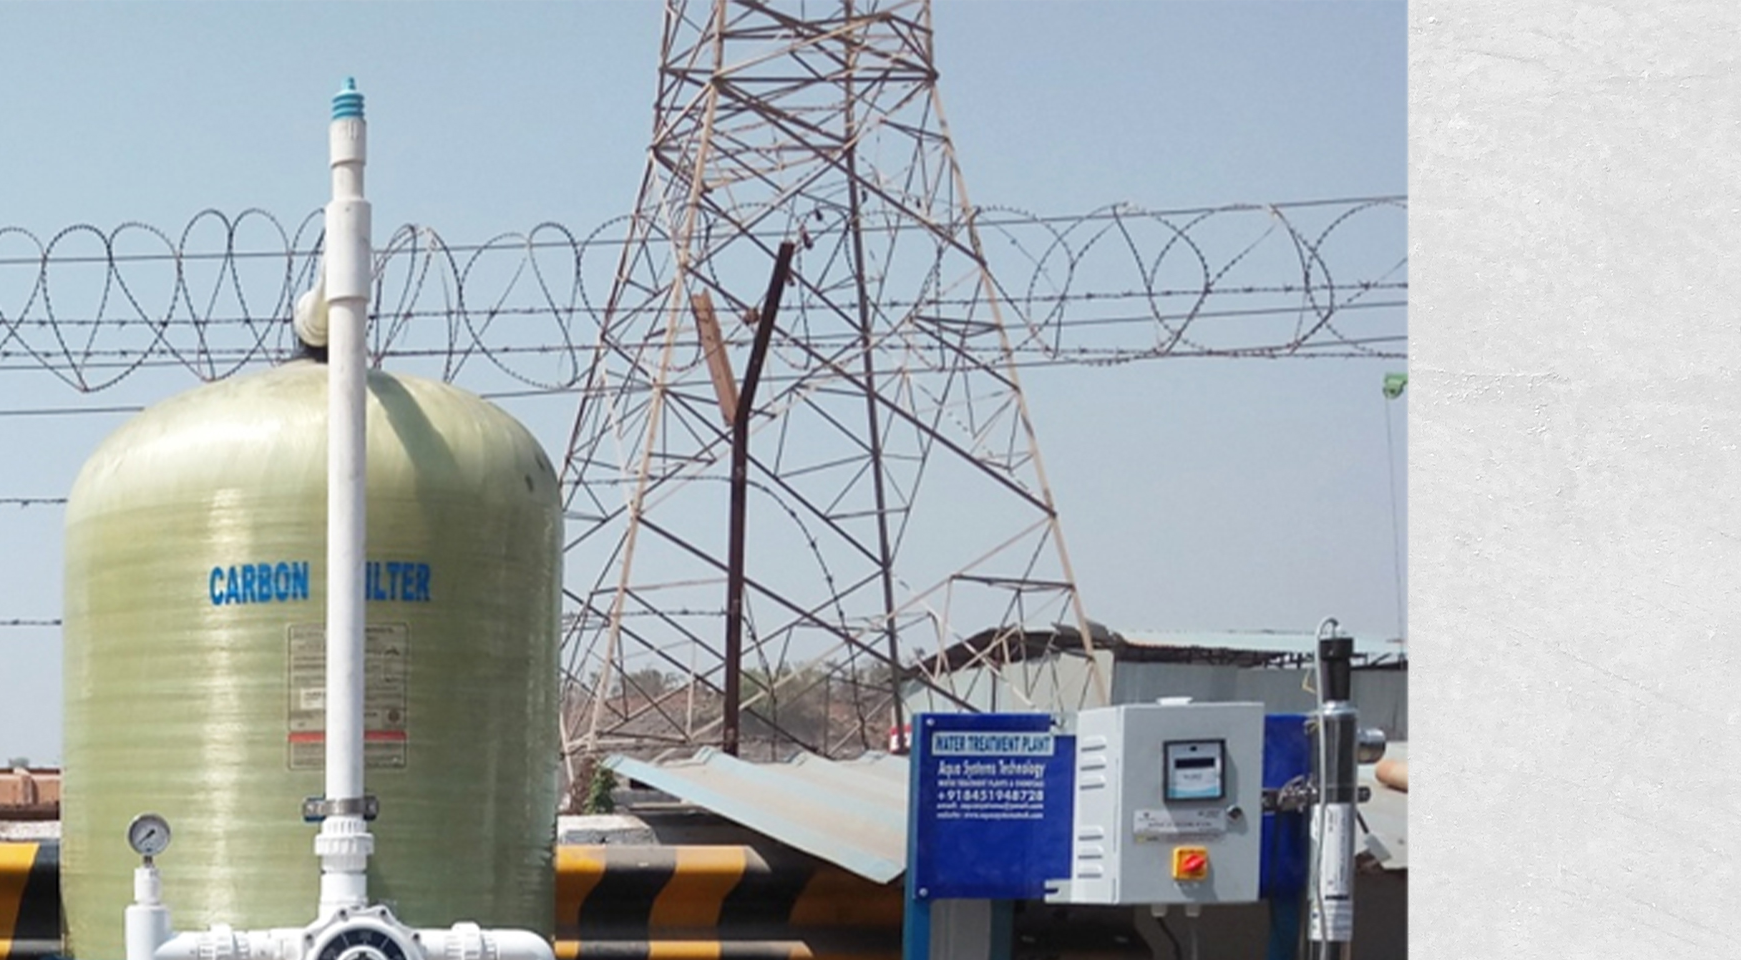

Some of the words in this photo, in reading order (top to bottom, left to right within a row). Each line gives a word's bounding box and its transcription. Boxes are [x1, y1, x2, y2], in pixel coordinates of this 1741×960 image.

[209, 561, 309, 606] CARBON
[365, 561, 432, 603] ILTER
[936, 735, 965, 752] WATER
[967, 735, 1019, 752] TREATMENT
[1022, 735, 1051, 752] PLANT
[938, 759, 961, 779] Aqua
[963, 759, 996, 779] Systems
[999, 759, 1046, 779] Technology
[938, 790, 1044, 801] +918451948728
